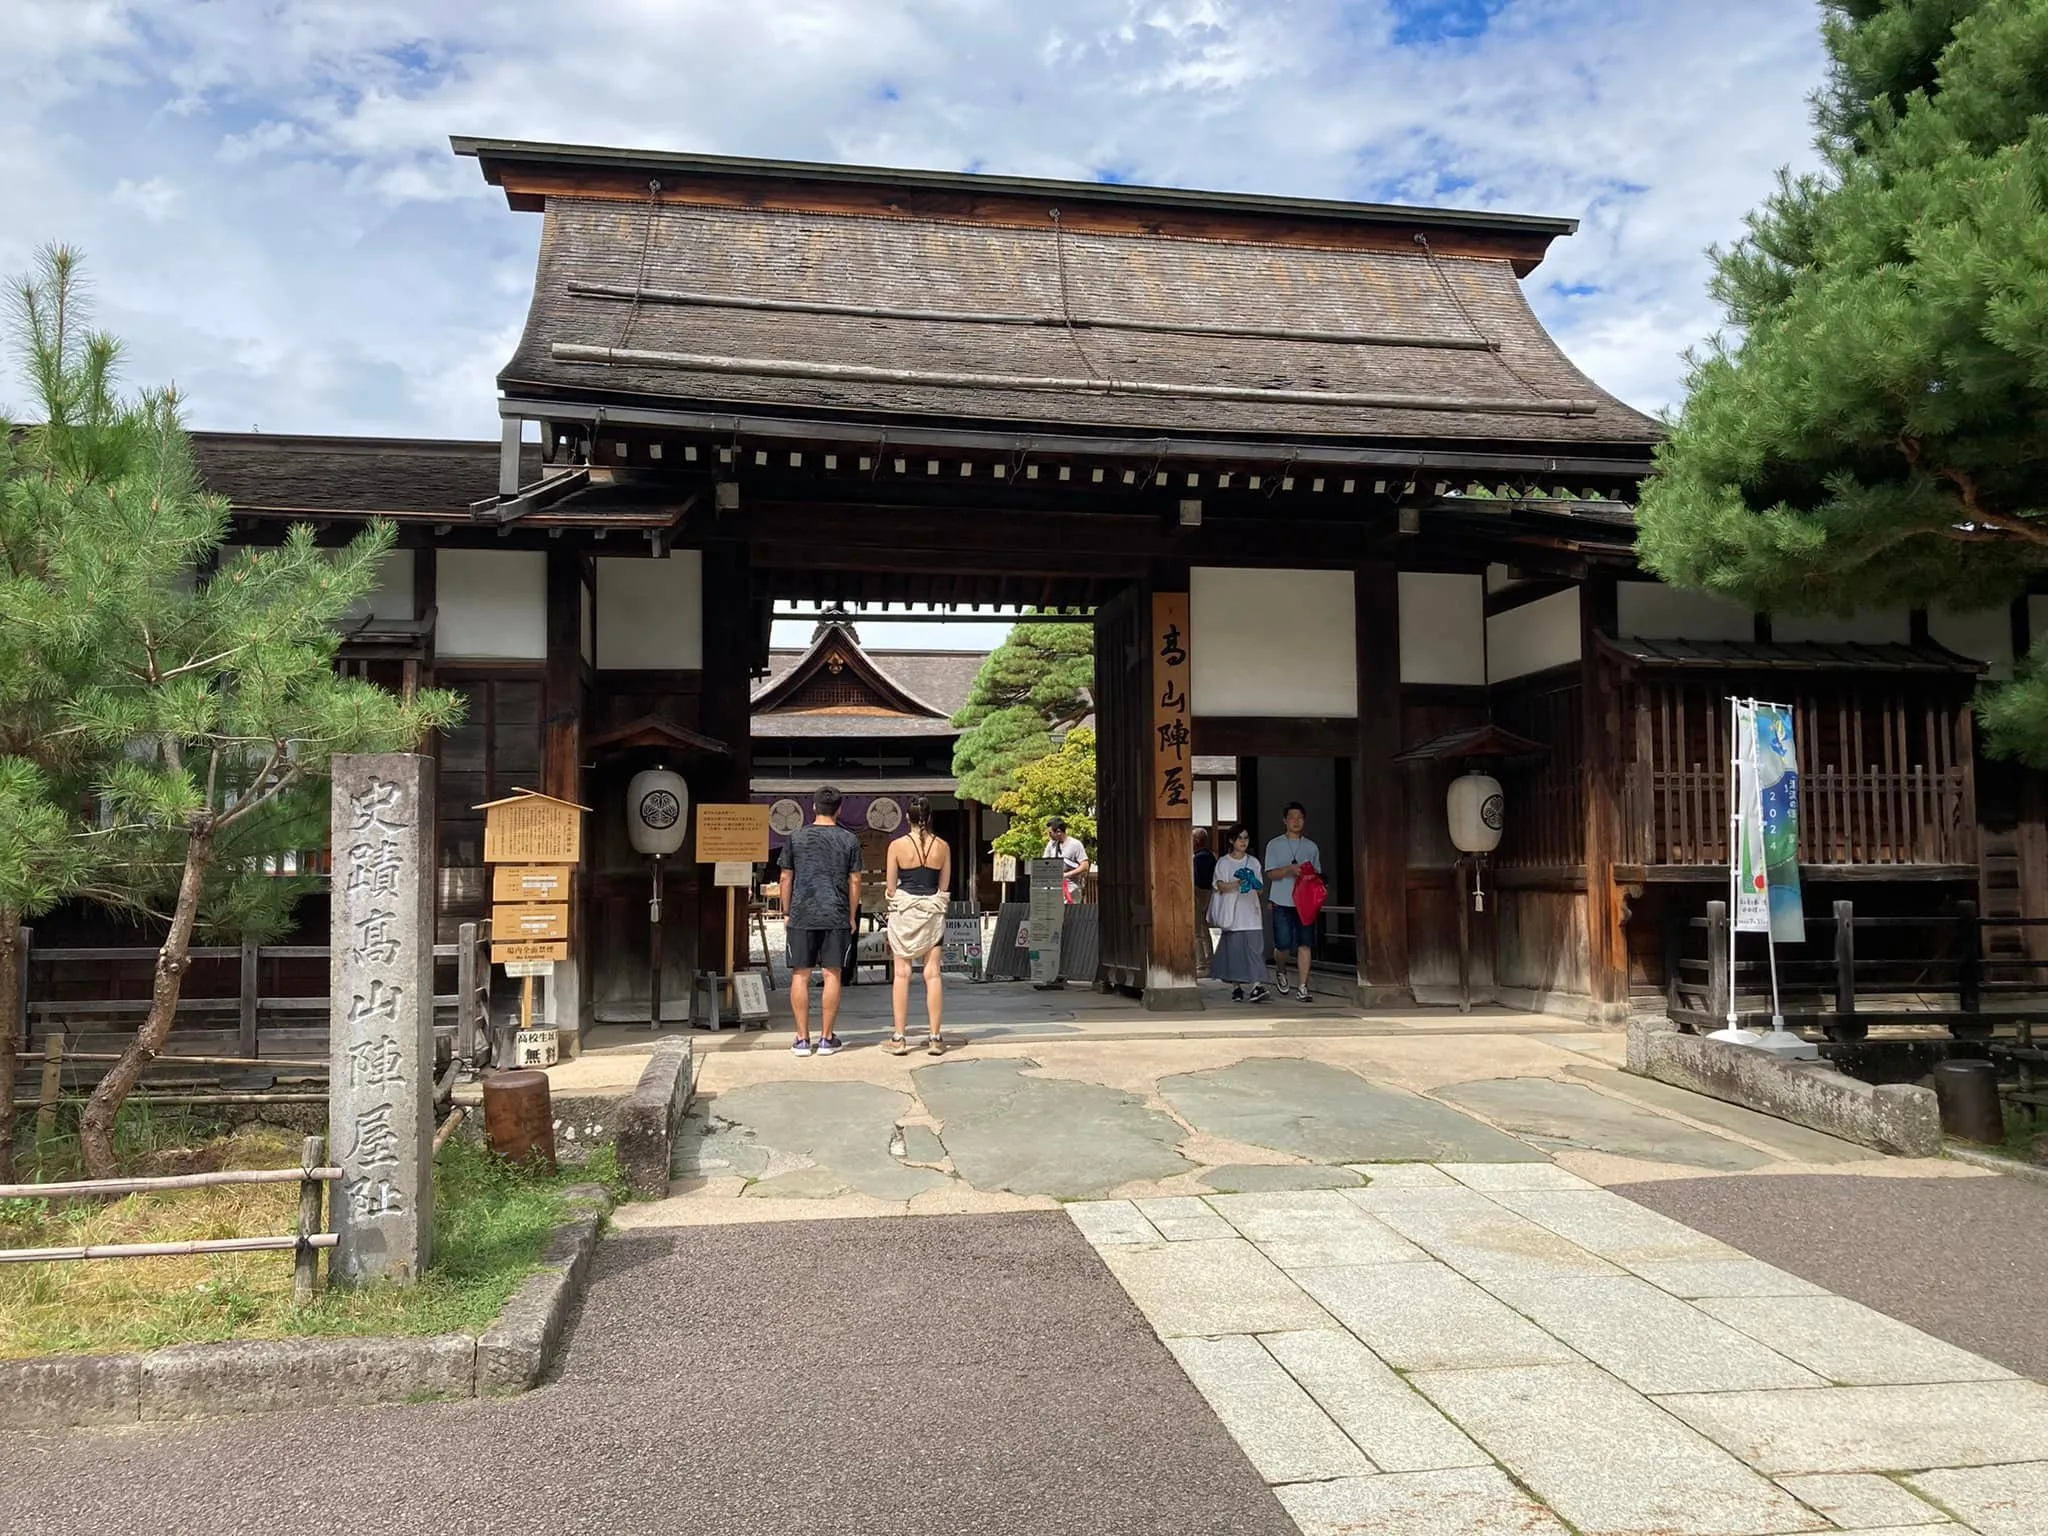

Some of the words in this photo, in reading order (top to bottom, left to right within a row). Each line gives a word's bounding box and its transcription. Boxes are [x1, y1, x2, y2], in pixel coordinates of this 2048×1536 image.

[1157, 624, 1190, 806] 高山陣屋
[1769, 792, 1777, 849] 2024
[525, 1046, 556, 1064] 無料
